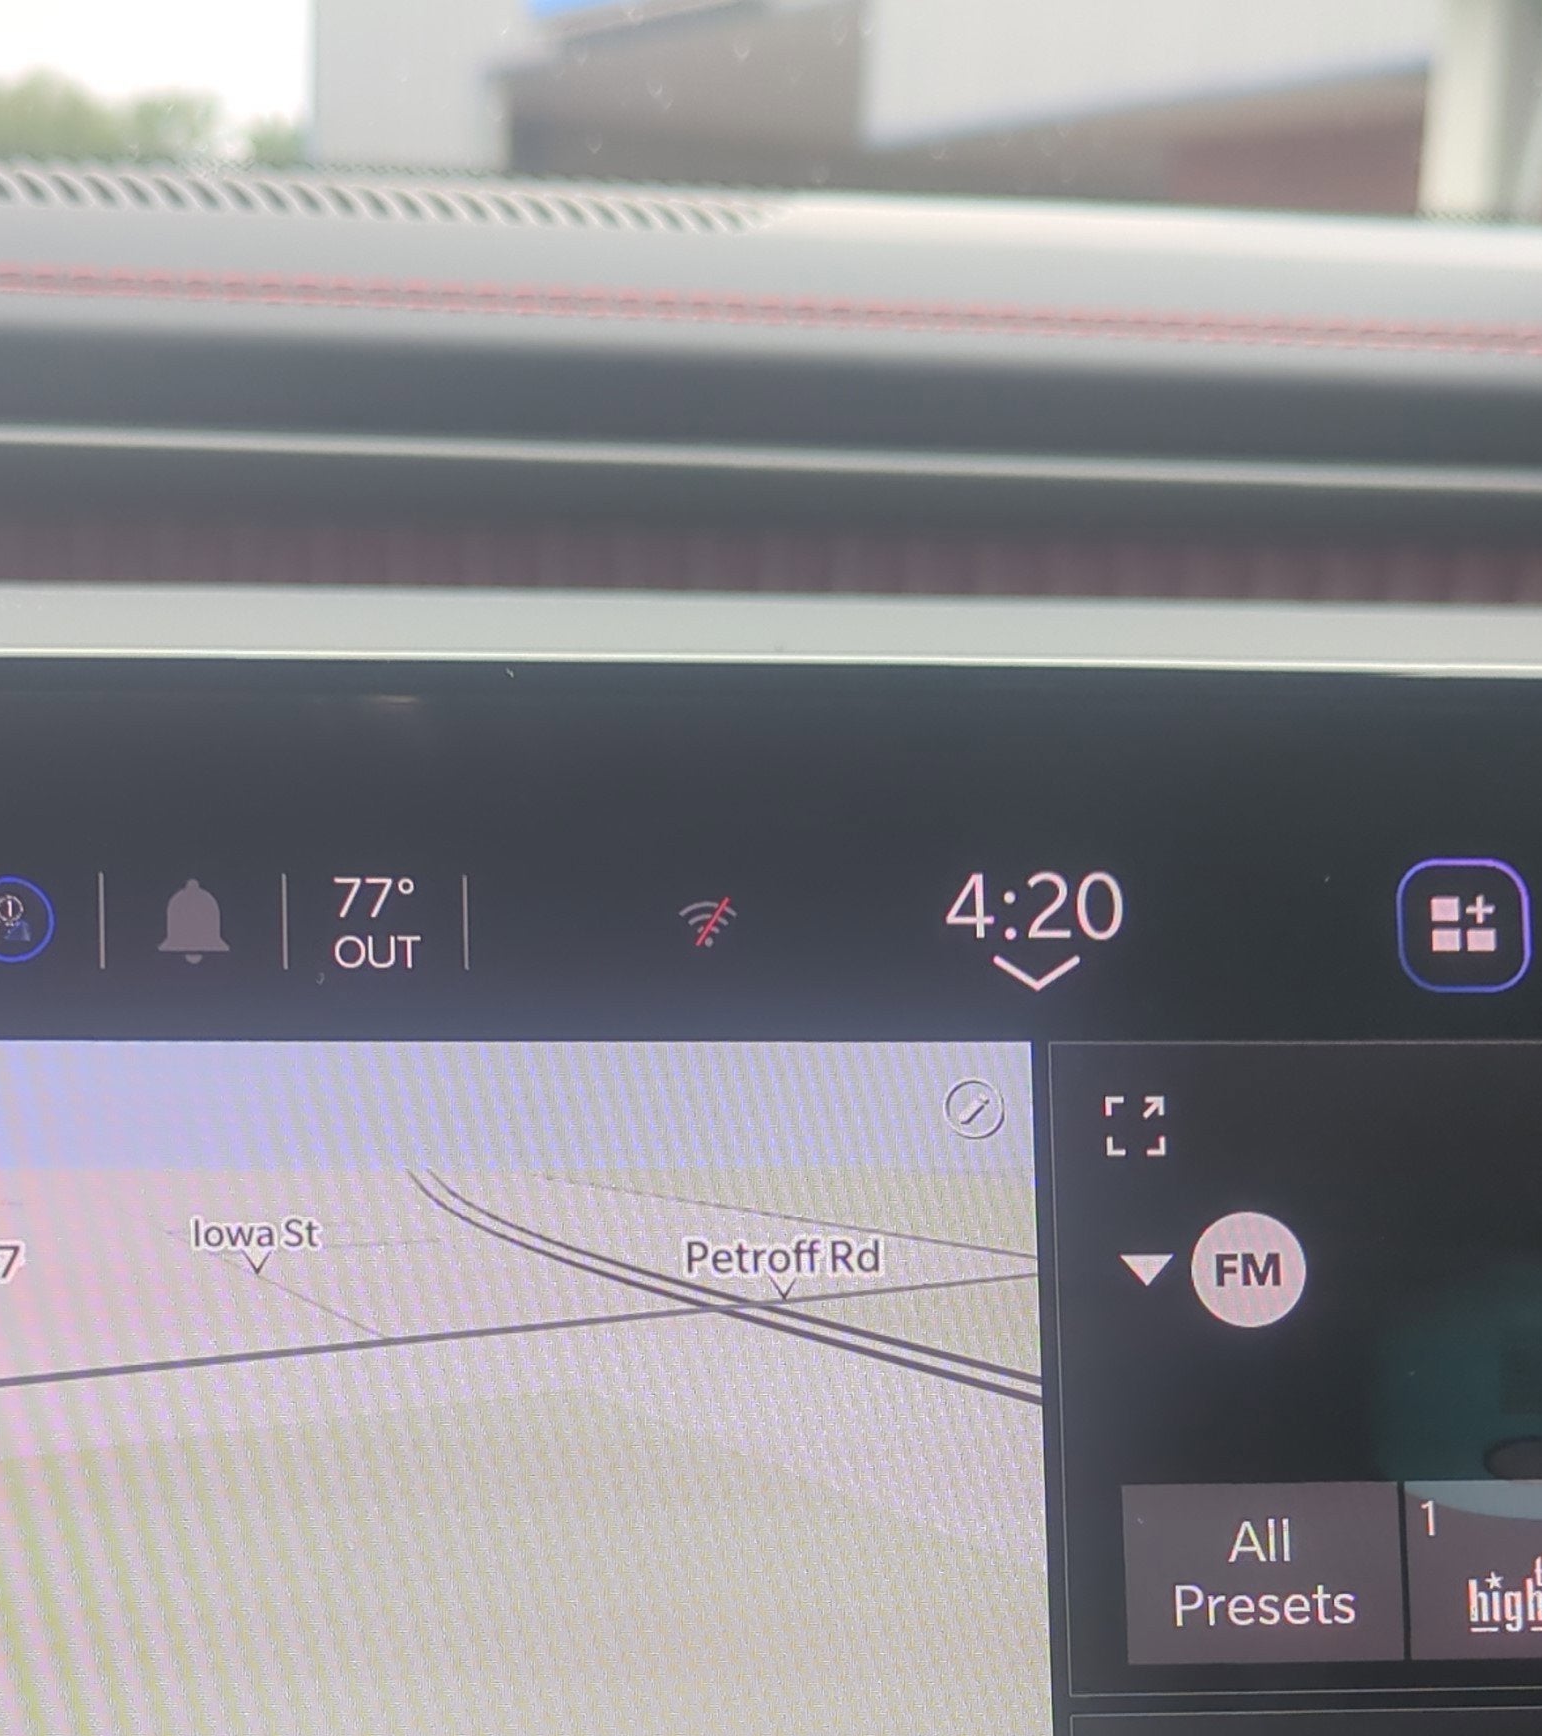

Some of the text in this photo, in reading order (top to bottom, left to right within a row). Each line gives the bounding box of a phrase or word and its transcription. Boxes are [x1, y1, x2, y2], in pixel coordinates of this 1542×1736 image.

[332, 876, 416, 920] 77°
[944, 870, 1125, 942] 4:20
[333, 936, 421, 970] OUT
[191, 1219, 320, 1250] Iowa St
[685, 1238, 882, 1275] Petroff Rd
[1213, 1251, 1283, 1288] FM
[1420, 1500, 1438, 1537] 1
[1228, 1517, 1292, 1564] All
[1174, 1583, 1357, 1629] Presets
